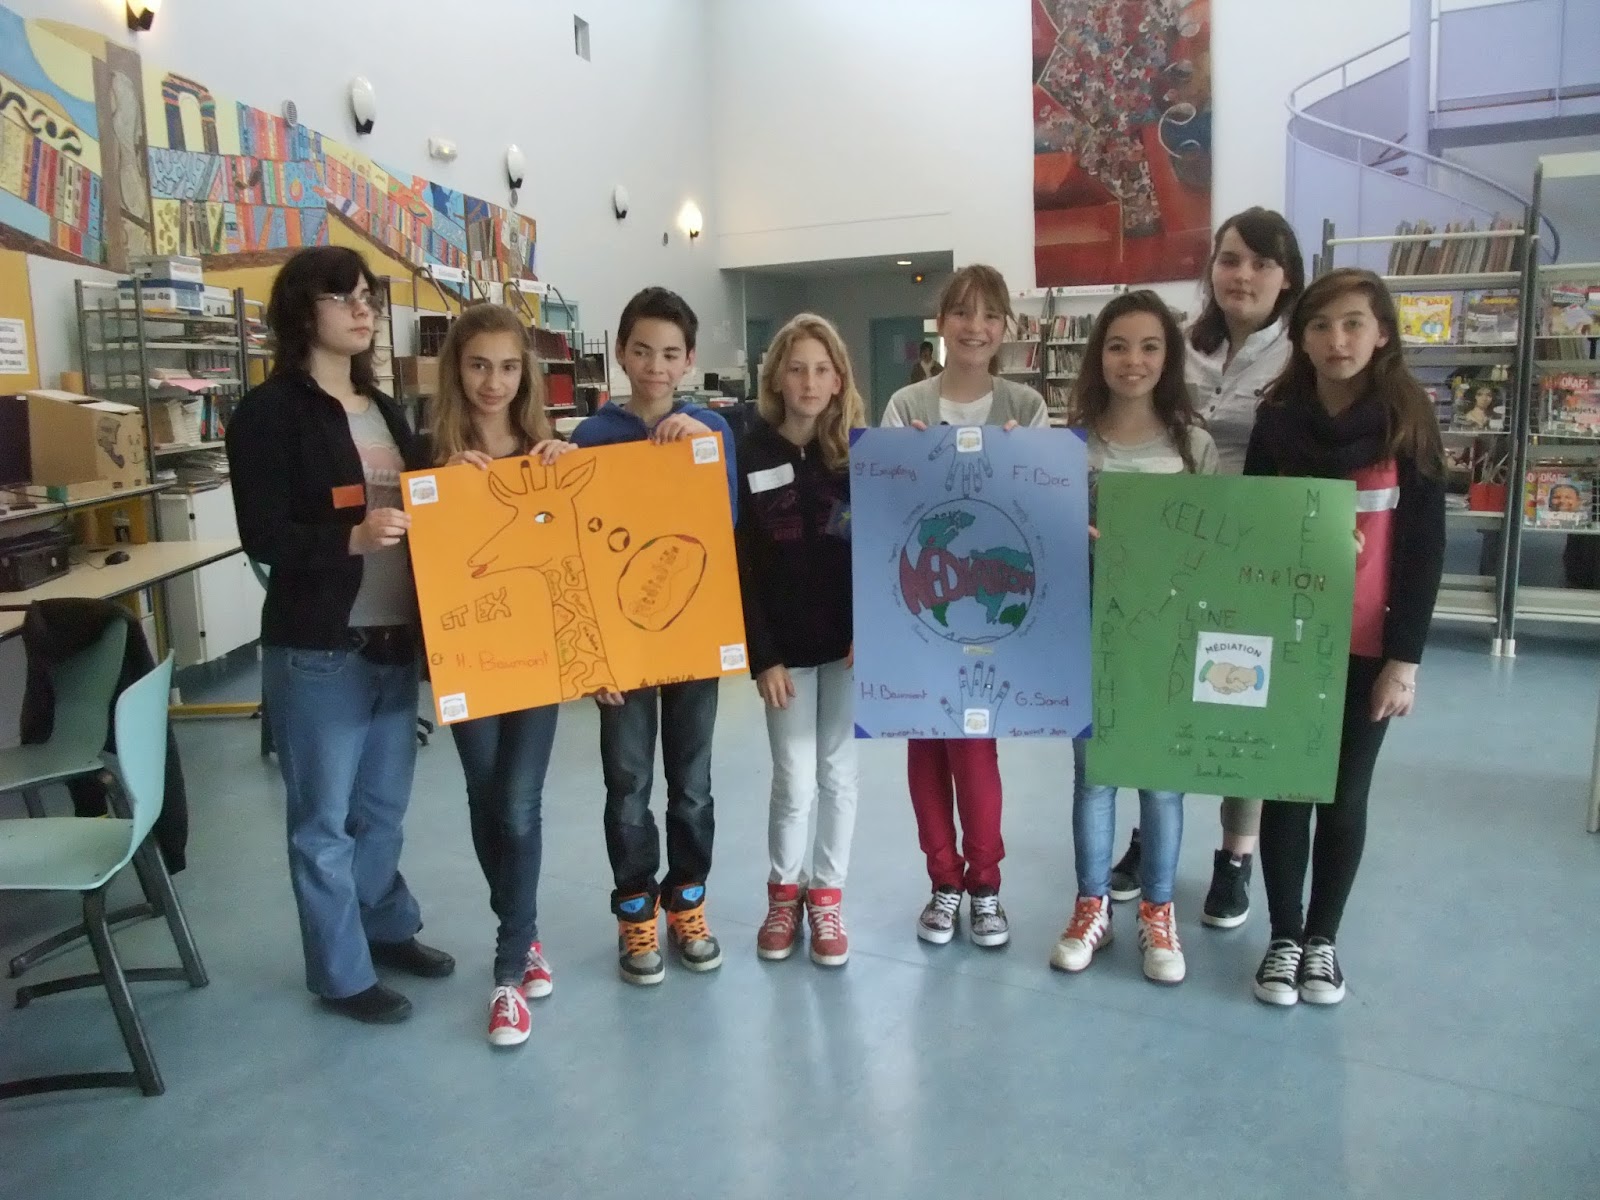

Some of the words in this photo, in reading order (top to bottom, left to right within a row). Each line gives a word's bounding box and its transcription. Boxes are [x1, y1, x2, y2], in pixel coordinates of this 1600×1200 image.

[1162, 499, 1255, 553] KELLY
[1238, 565, 1327, 593] MARION
[1205, 642, 1262, 658] MÉDIATION
